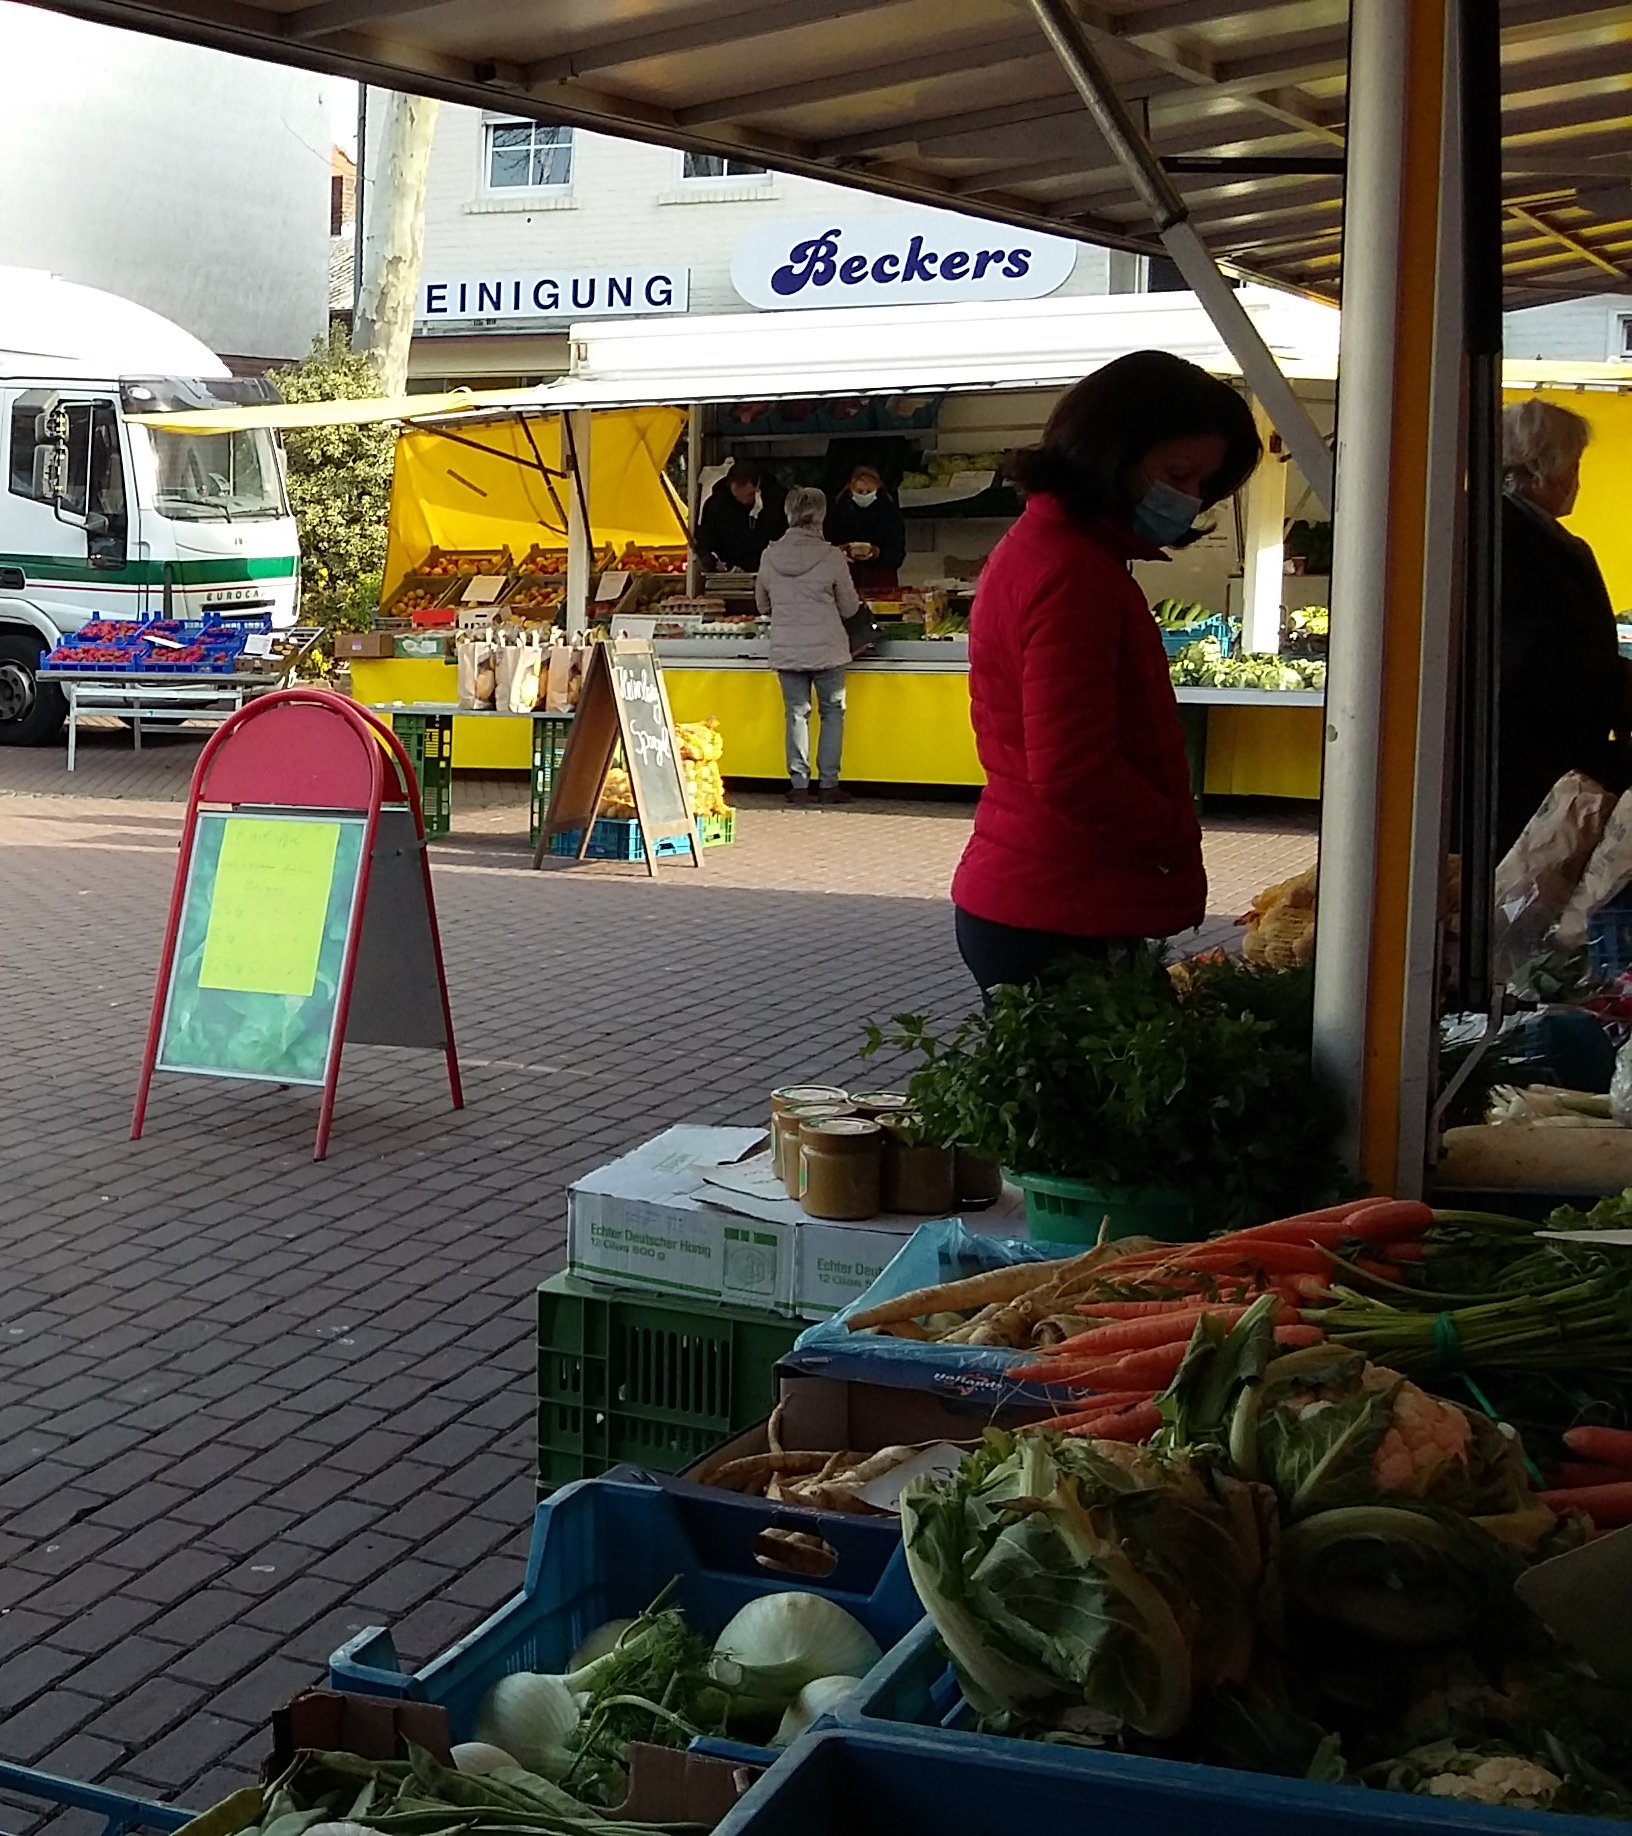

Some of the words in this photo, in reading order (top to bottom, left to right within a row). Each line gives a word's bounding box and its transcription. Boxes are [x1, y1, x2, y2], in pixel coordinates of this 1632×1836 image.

[770, 228, 1032, 296] Beckers
[590, 1222, 623, 1239] Echter
[624, 1229, 678, 1250] Deutscher
[680, 1240, 712, 1259] Honig
[817, 1258, 853, 1274] Echter
[818, 1274, 830, 1283] 12
